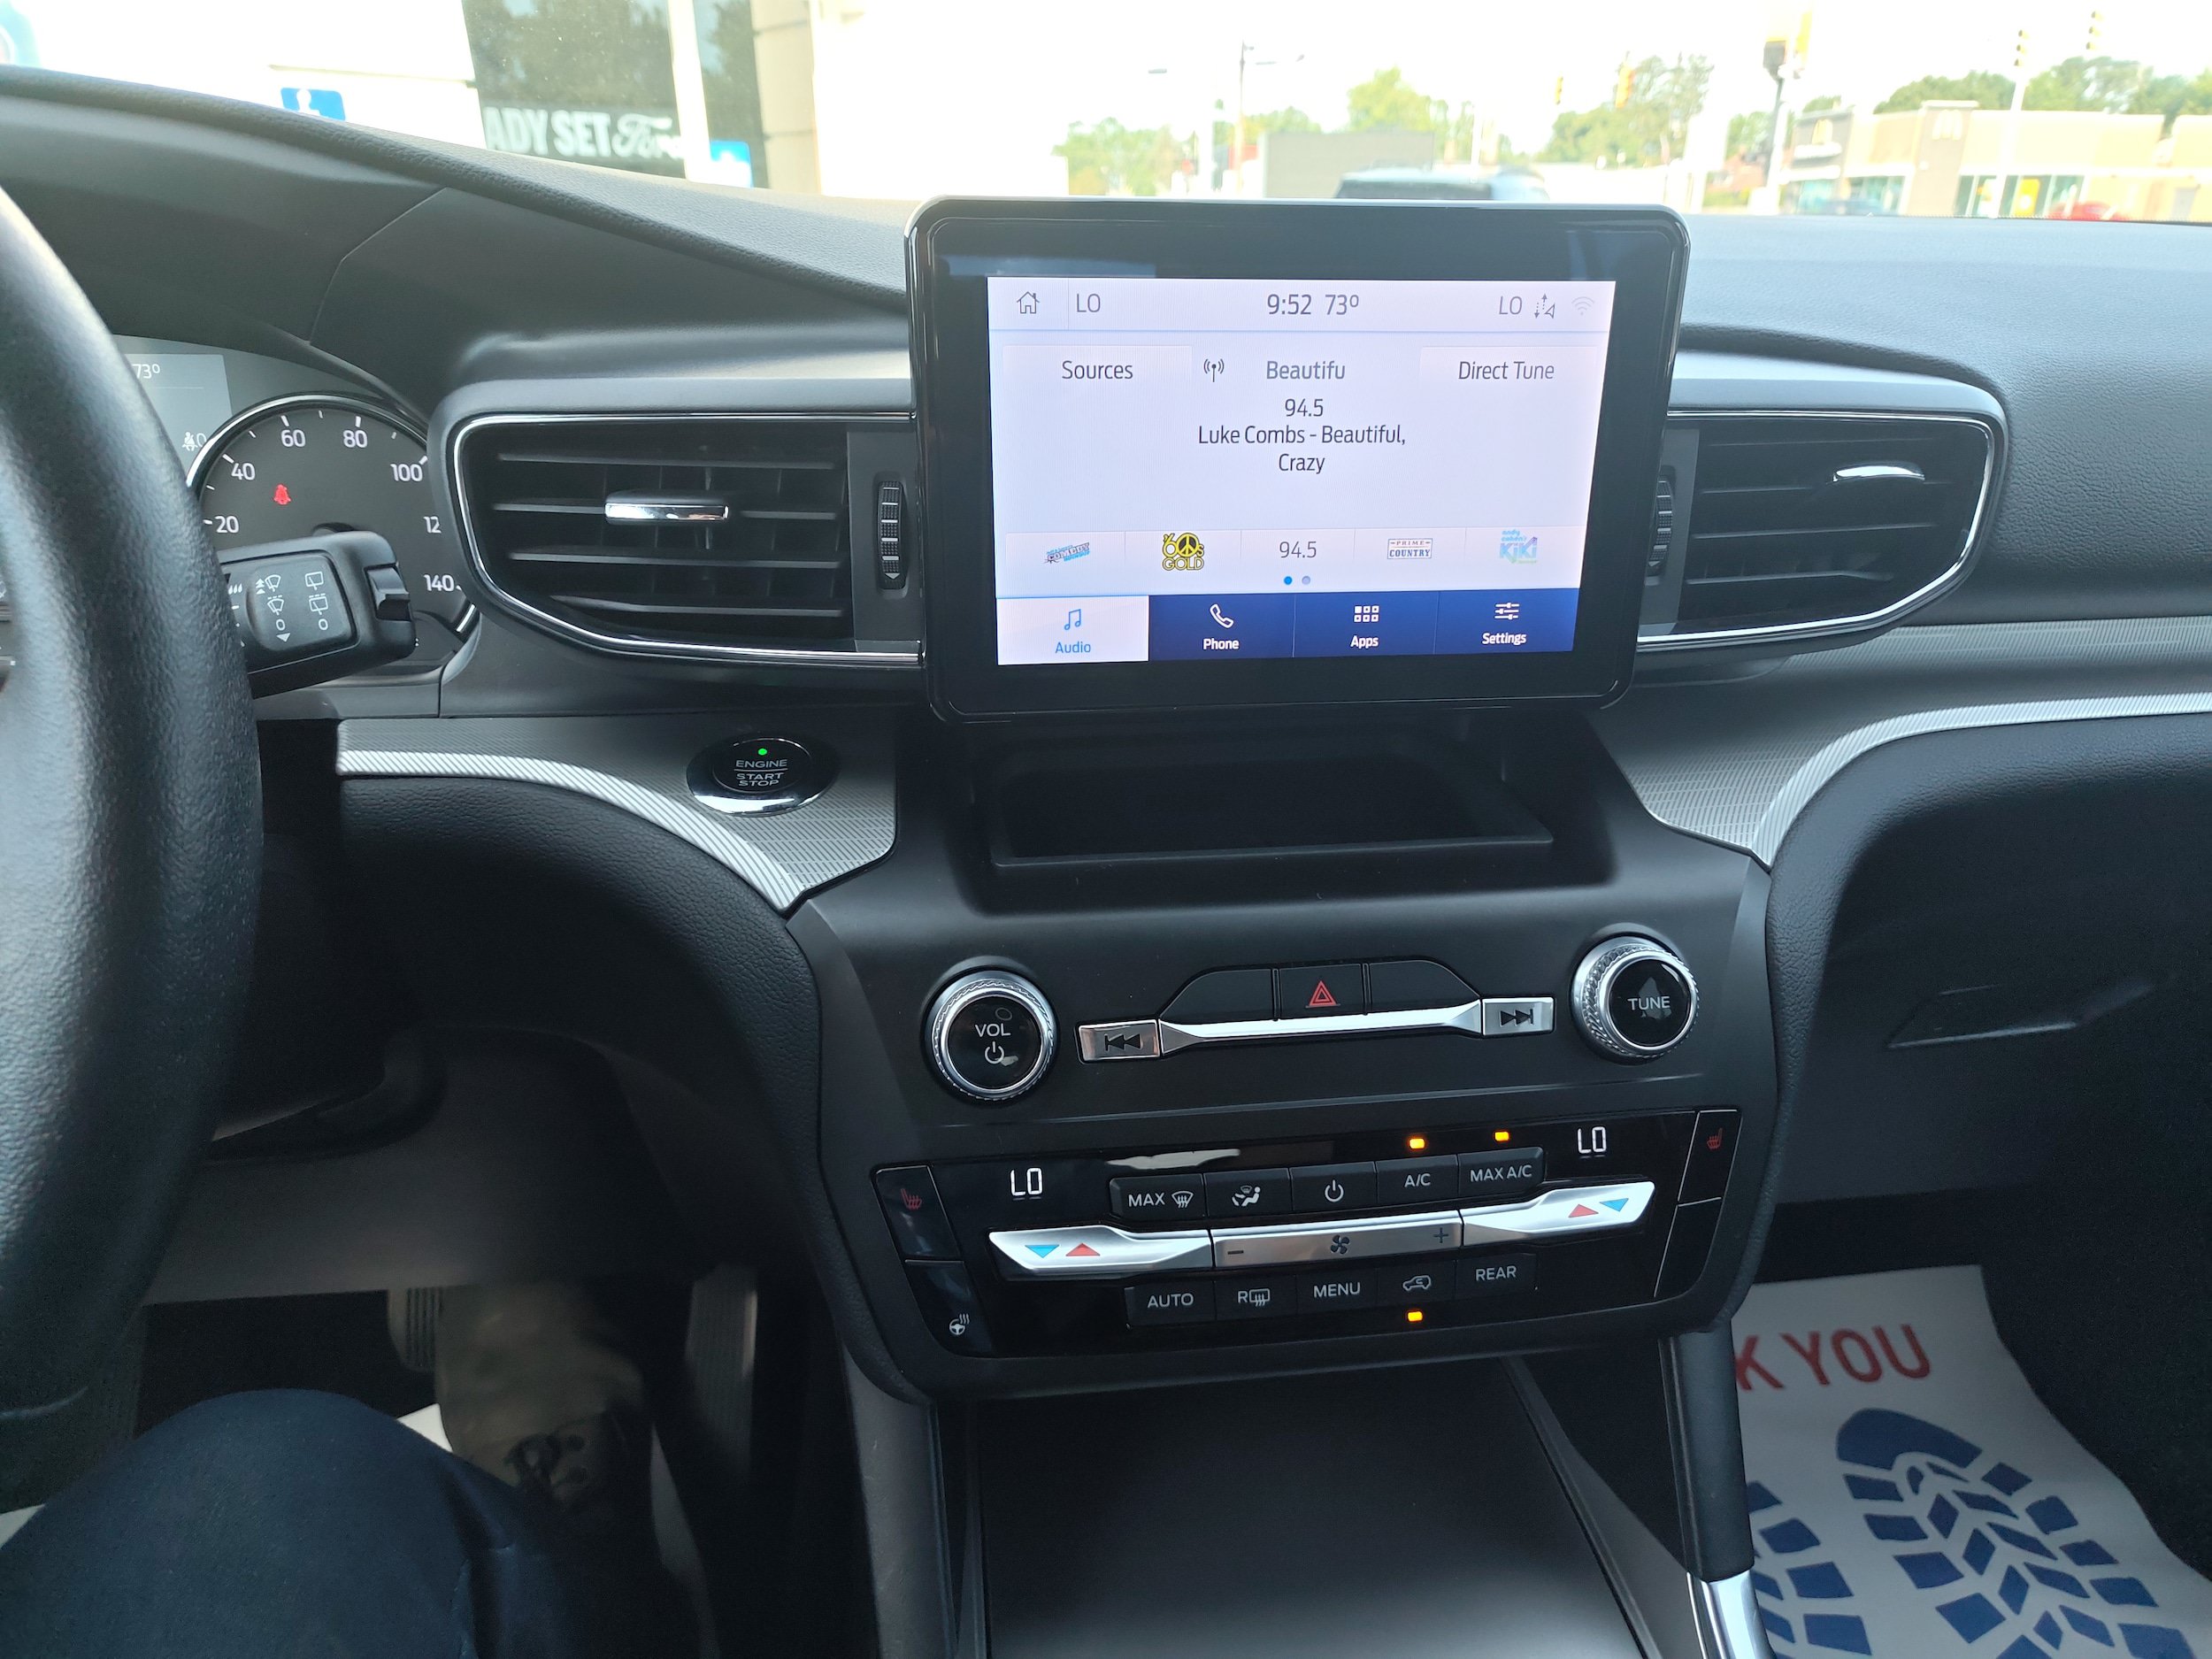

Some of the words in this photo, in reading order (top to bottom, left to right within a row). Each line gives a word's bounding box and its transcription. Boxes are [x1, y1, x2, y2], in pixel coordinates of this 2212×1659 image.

[550, 110, 611, 157] SET
[1076, 293, 1102, 313] LO
[1266, 293, 1312, 316] 9:52
[1498, 296, 1523, 316] LO
[1061, 359, 1133, 380] Sources
[1265, 359, 1346, 380] Beautifu
[1458, 360, 1509, 380] Direct
[1513, 360, 1555, 380] Tune
[1284, 398, 1325, 418] 94.5
[280, 429, 306, 448] 60
[342, 429, 368, 449] 80
[1198, 425, 1240, 444] Luke
[1244, 425, 1305, 444] Combs
[1321, 425, 1406, 445] Beautiful,
[231, 462, 256, 481] 40
[390, 463, 424, 482] 100
[1278, 453, 1325, 474] Crazy
[214, 515, 240, 534] 20
[423, 516, 442, 534] 12
[1279, 541, 1317, 559] 94.5
[1389, 549, 1431, 557] COUNTRY
[1162, 557, 1205, 571] GOLD
[423, 573, 455, 592] 140
[1055, 641, 1092, 655] Audio
[1202, 638, 1240, 650] Phone
[1350, 634, 1379, 649] Apps
[1481, 632, 1527, 646] Settings
[735, 759, 788, 768] ENGINE
[1627, 995, 1671, 1011] TUNE
[974, 1023, 1011, 1038] VOL
[1577, 1125, 1608, 1155] LO
[1010, 1167, 1044, 1197] LO
[1403, 1172, 1432, 1187] A/C
[1470, 1166, 1504, 1182] MAX
[1505, 1164, 1532, 1179] A/C
[1128, 1192, 1166, 1207] MAX
[1475, 1264, 1517, 1281] REAR
[1313, 1281, 1361, 1298] MENU
[1147, 1292, 1194, 1309] AUTO
[1780, 1324, 1932, 1387] YOU
